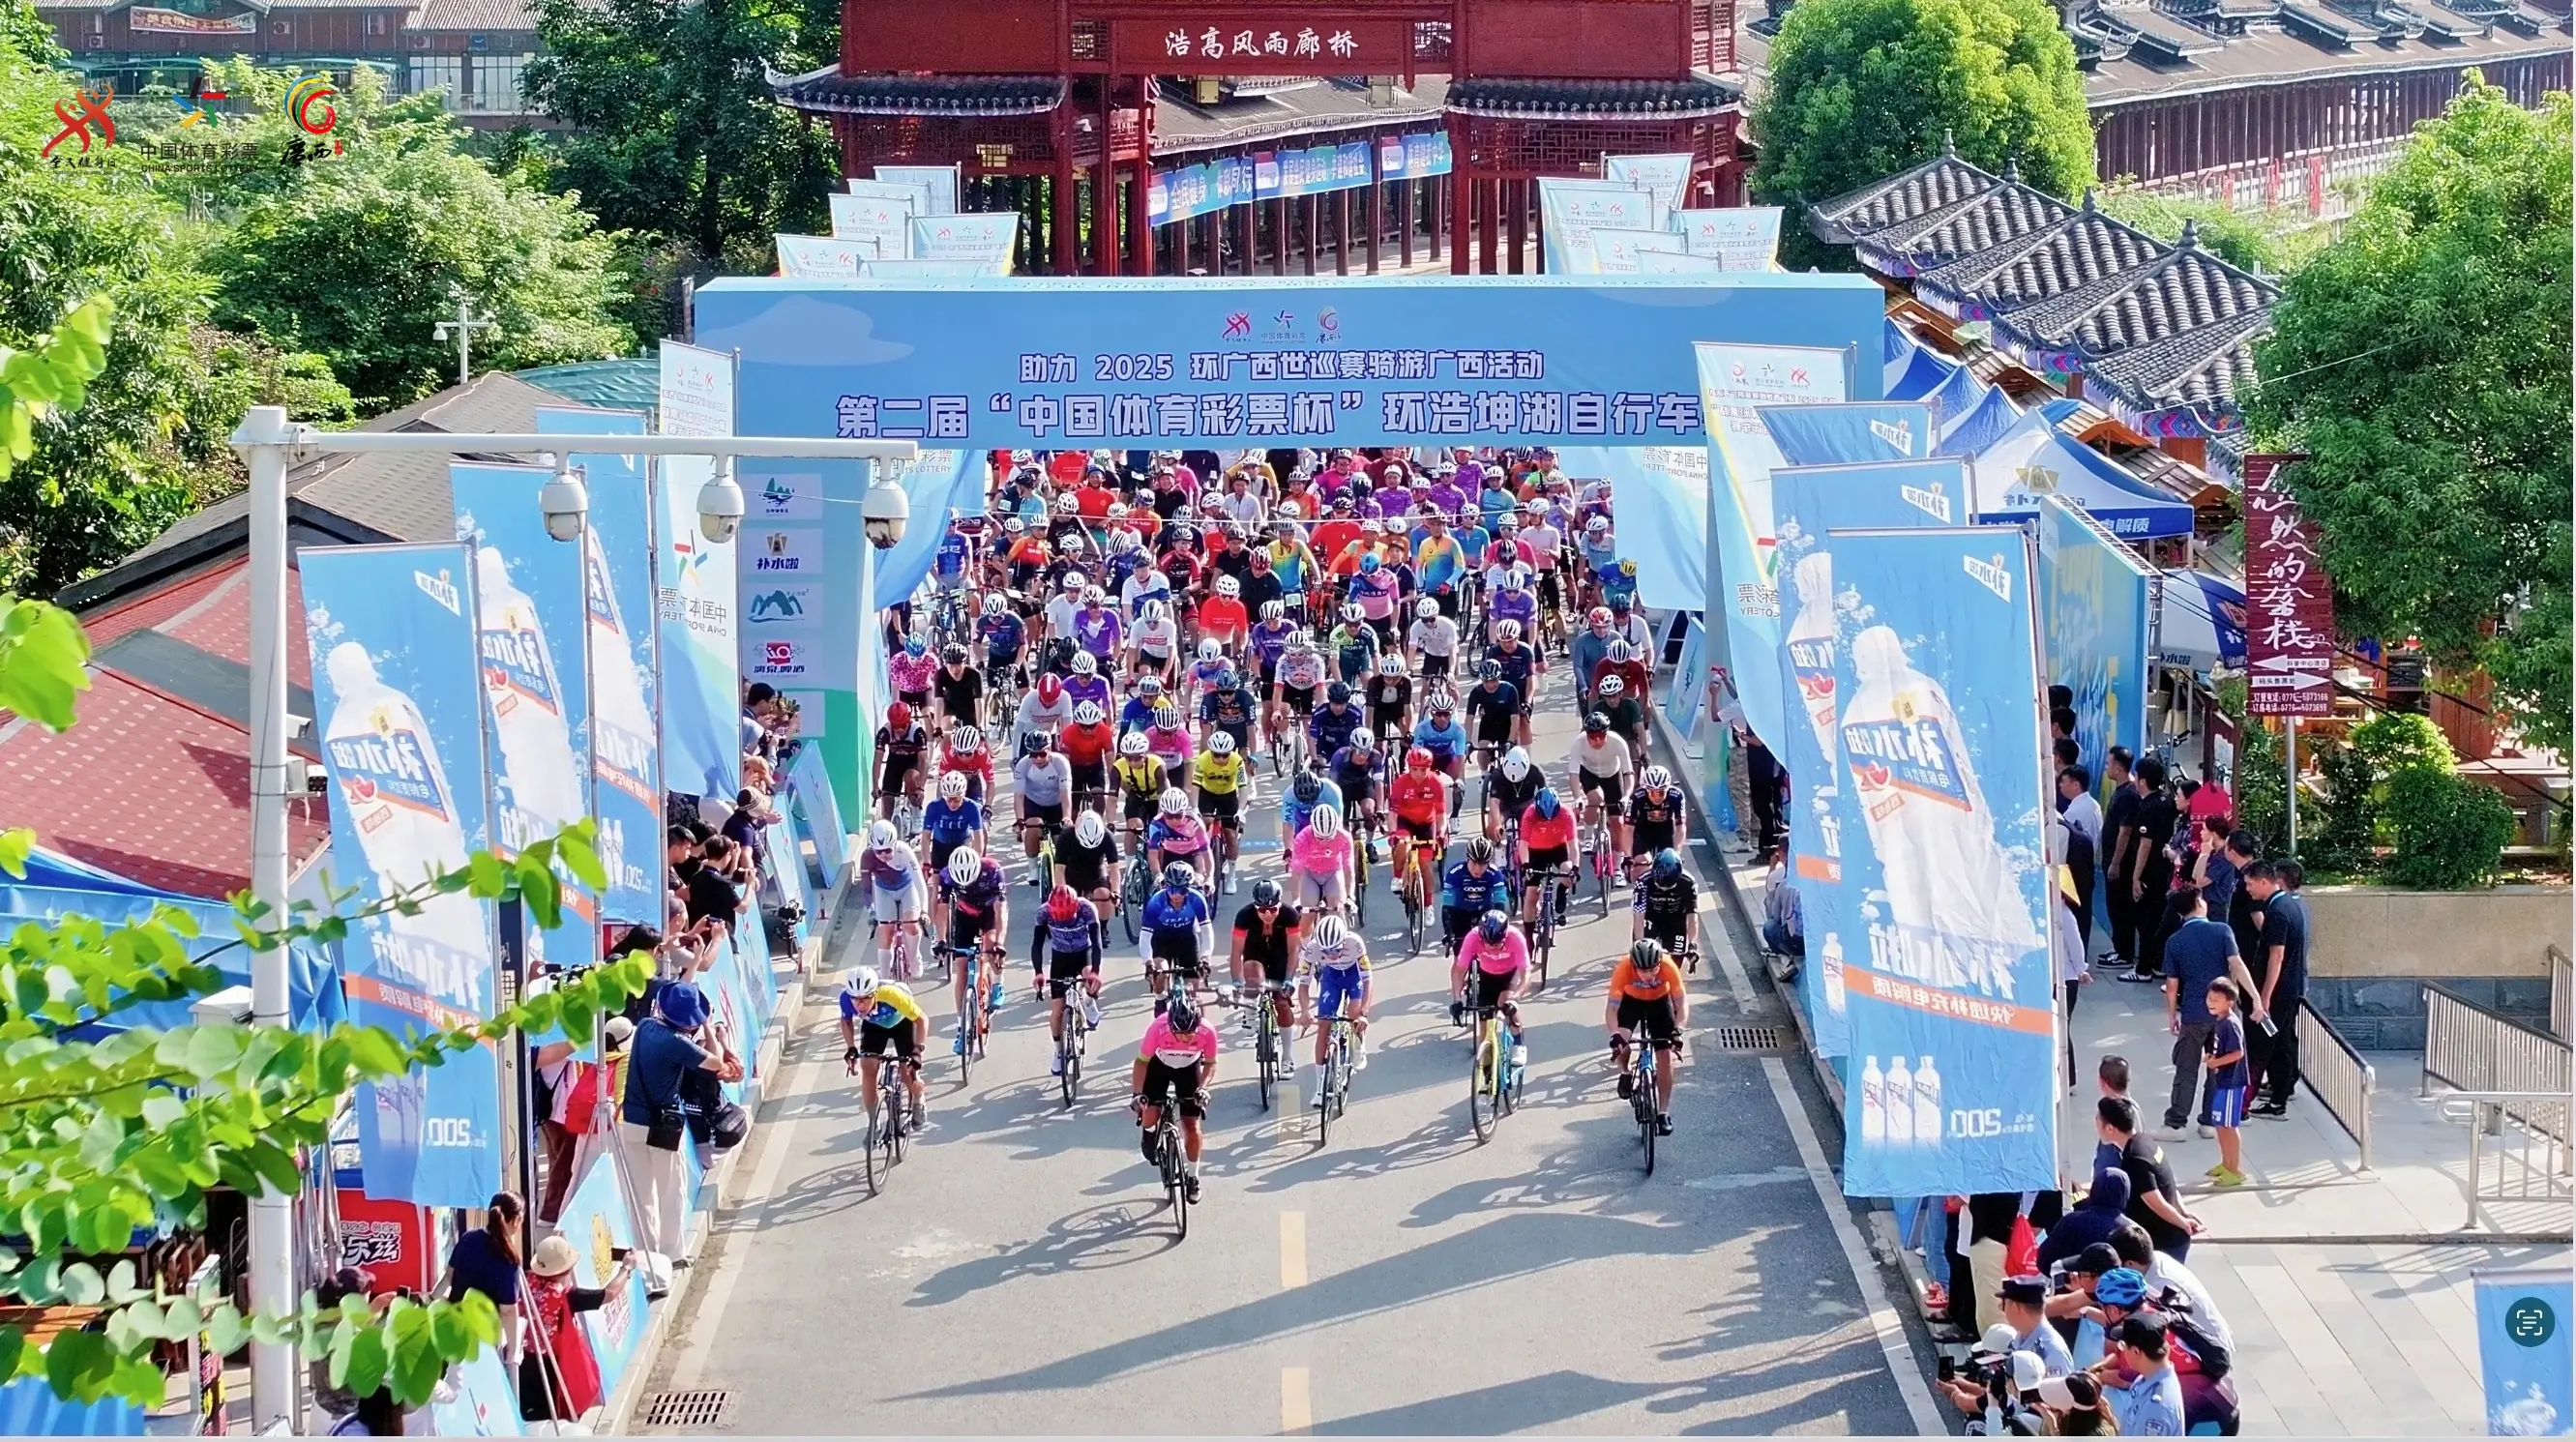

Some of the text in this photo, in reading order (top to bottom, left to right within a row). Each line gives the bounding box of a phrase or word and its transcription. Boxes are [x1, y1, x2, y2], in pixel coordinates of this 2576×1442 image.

[1171, 174, 1207, 211] 全民健身
[1020, 352, 1544, 383] 助力 2025 环广西世巡赛骑游广西活动
[836, 395, 1706, 438] 第二届“中国体育彩票杯”环浩坤湖自行车
[757, 558, 800, 570] 补水啦
[342, 1233, 400, 1267] 乐兹
